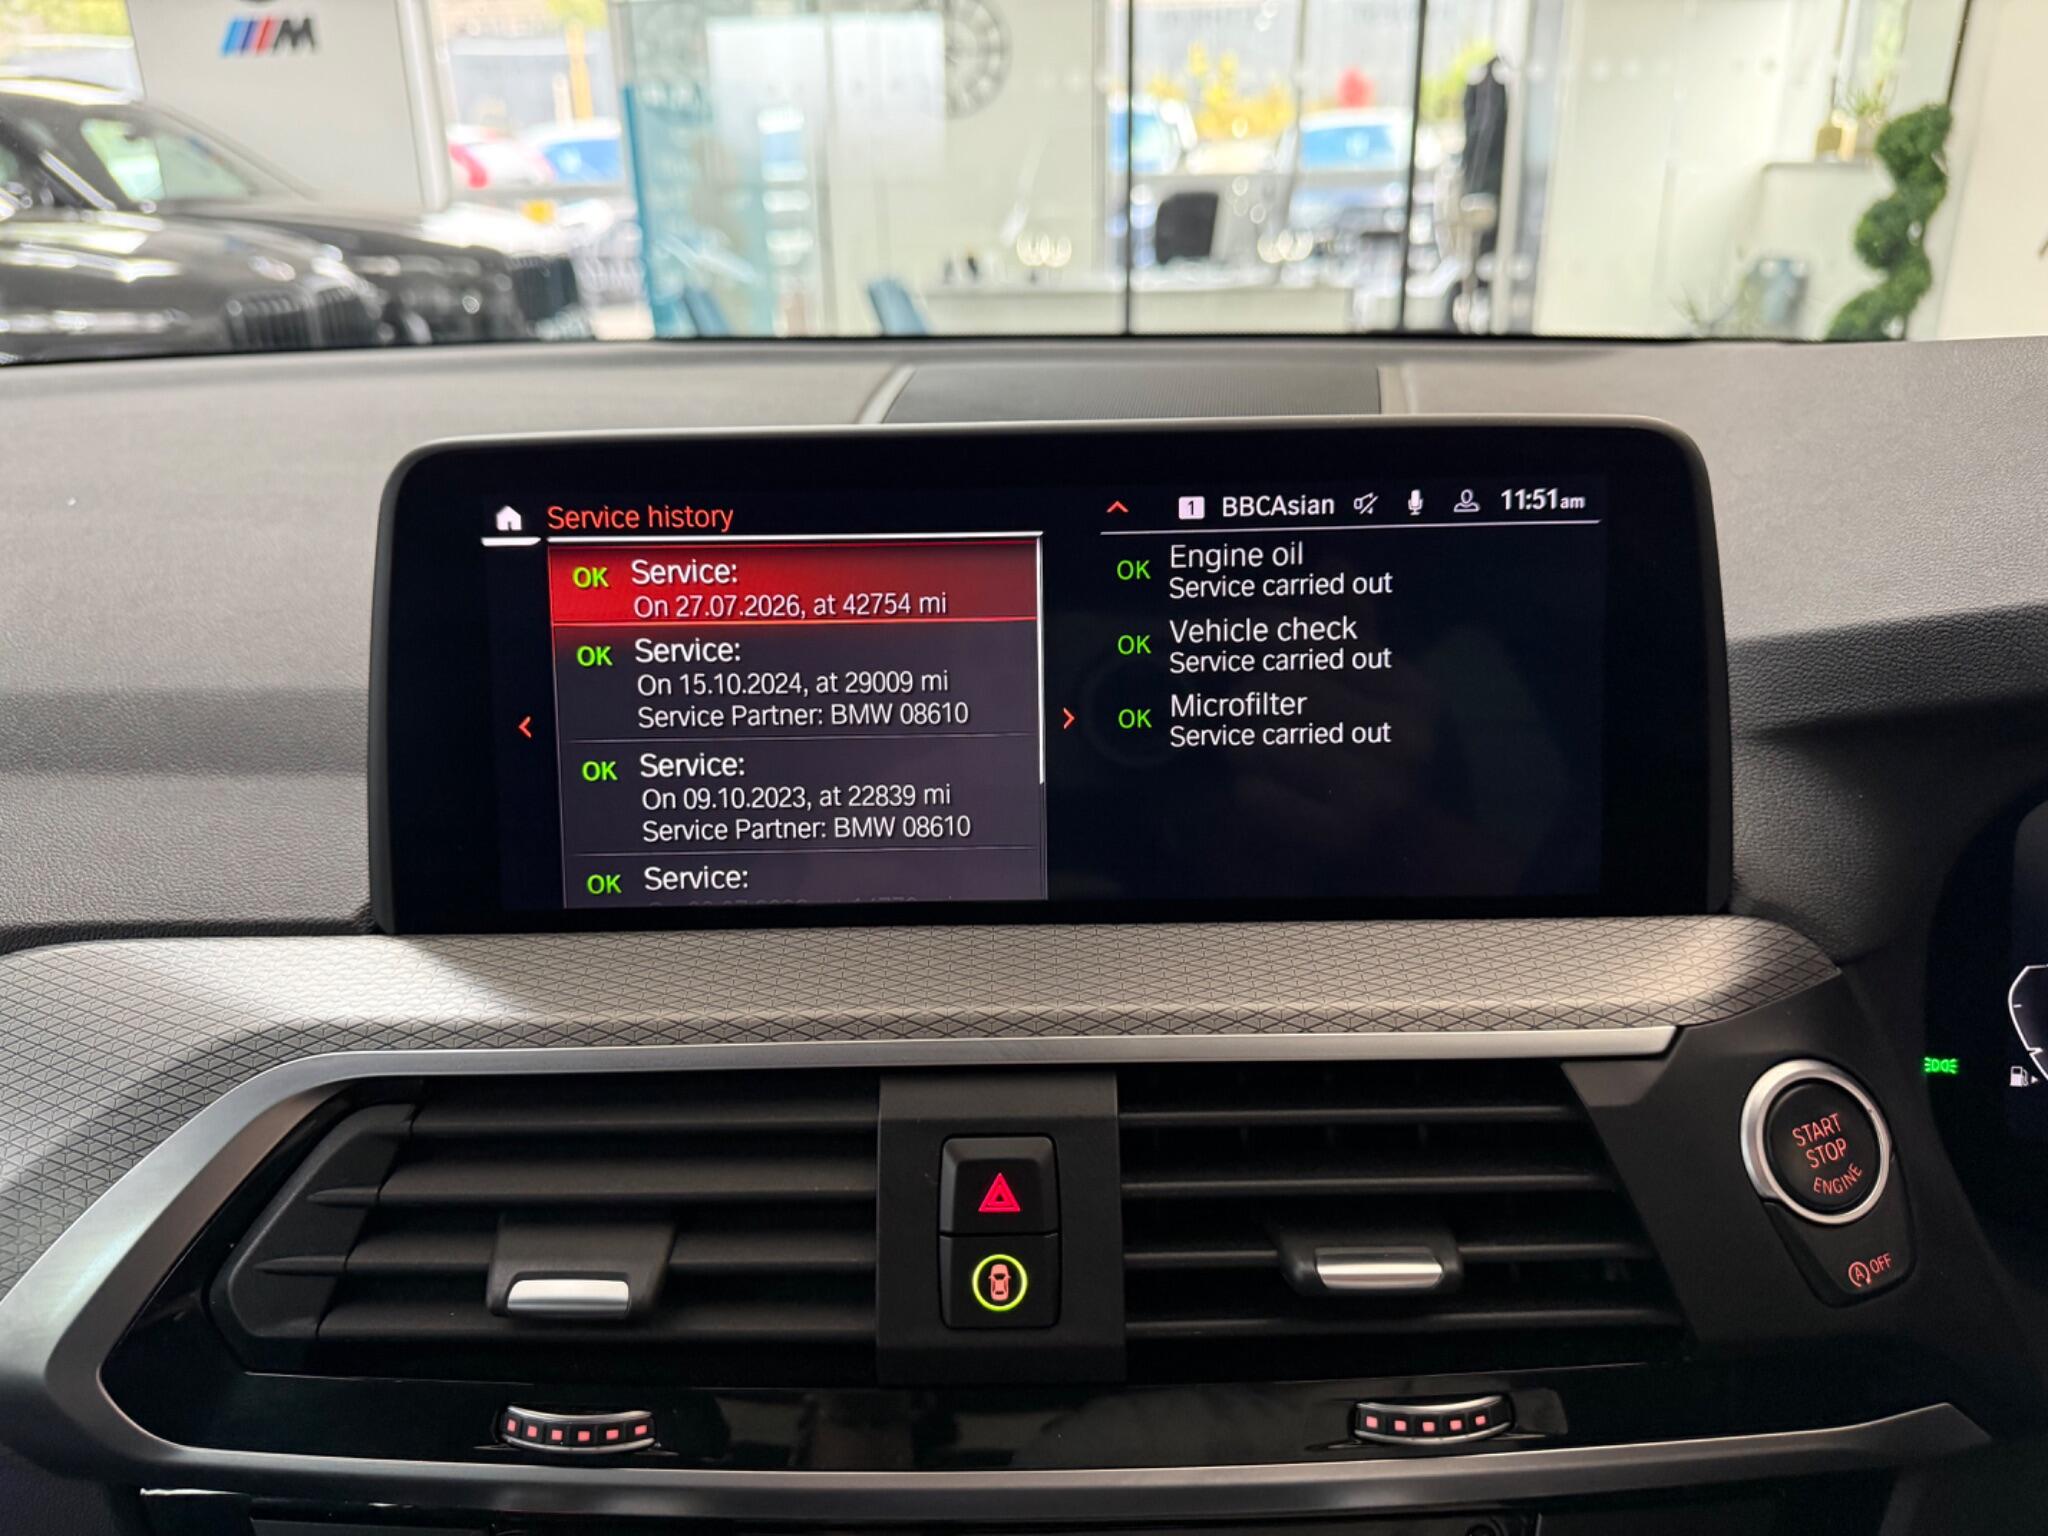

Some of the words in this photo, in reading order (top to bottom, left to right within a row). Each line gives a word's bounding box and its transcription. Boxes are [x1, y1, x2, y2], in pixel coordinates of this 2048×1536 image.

[547, 506, 640, 530] Service
[648, 503, 734, 533] history
[1116, 559, 1151, 581] OK
[1171, 544, 1264, 573] Engine
[1272, 541, 1304, 568] oil
[572, 566, 608, 589] OK
[631, 559, 738, 585] Service:
[1169, 575, 1256, 599] Service
[1262, 573, 1345, 597] carried
[1352, 572, 1393, 595] out
[634, 595, 669, 619] On
[675, 594, 807, 619] 27.07.2026,
[813, 594, 837, 616] at
[842, 594, 912, 615] 42754
[919, 591, 947, 615] mi
[1170, 618, 1269, 643] Vehicle
[1277, 616, 1358, 641] check
[577, 645, 612, 667] OK
[635, 638, 741, 664] Service:
[1117, 634, 1152, 656] OK
[1169, 651, 1256, 674] Service
[1262, 648, 1345, 671] carried
[1352, 646, 1392, 670] out
[637, 673, 673, 697] On
[679, 672, 808, 696] 15.10.2024,
[816, 672, 839, 694] at
[845, 671, 914, 694] 29009
[920, 668, 949, 692] mi
[638, 705, 726, 729] Service
[732, 705, 823, 728] Partner:
[831, 704, 893, 727] BMW
[899, 702, 969, 725] 08610
[1118, 708, 1152, 729] OK
[1170, 692, 1308, 718] Microfilter
[1170, 725, 1256, 748] Service
[1262, 722, 1345, 746] carried
[1351, 721, 1391, 744] out
[582, 760, 617, 782] OK
[640, 752, 745, 779] Service:
[642, 786, 677, 810] On
[683, 785, 812, 810] 09.10.2023,
[819, 786, 843, 808] at
[848, 785, 916, 807] 22839
[924, 782, 951, 806] mi
[643, 818, 728, 843] Service
[735, 817, 826, 841] Partner:
[834, 817, 896, 839] BMW
[902, 815, 971, 838] 08610
[586, 873, 621, 895] OK
[643, 864, 748, 892] Service:
[1792, 1112, 1841, 1148] START
[1806, 1138, 1847, 1169] STOP
[1813, 1162, 1863, 1196] ENGINE
[1870, 1252, 1892, 1274] OFF
